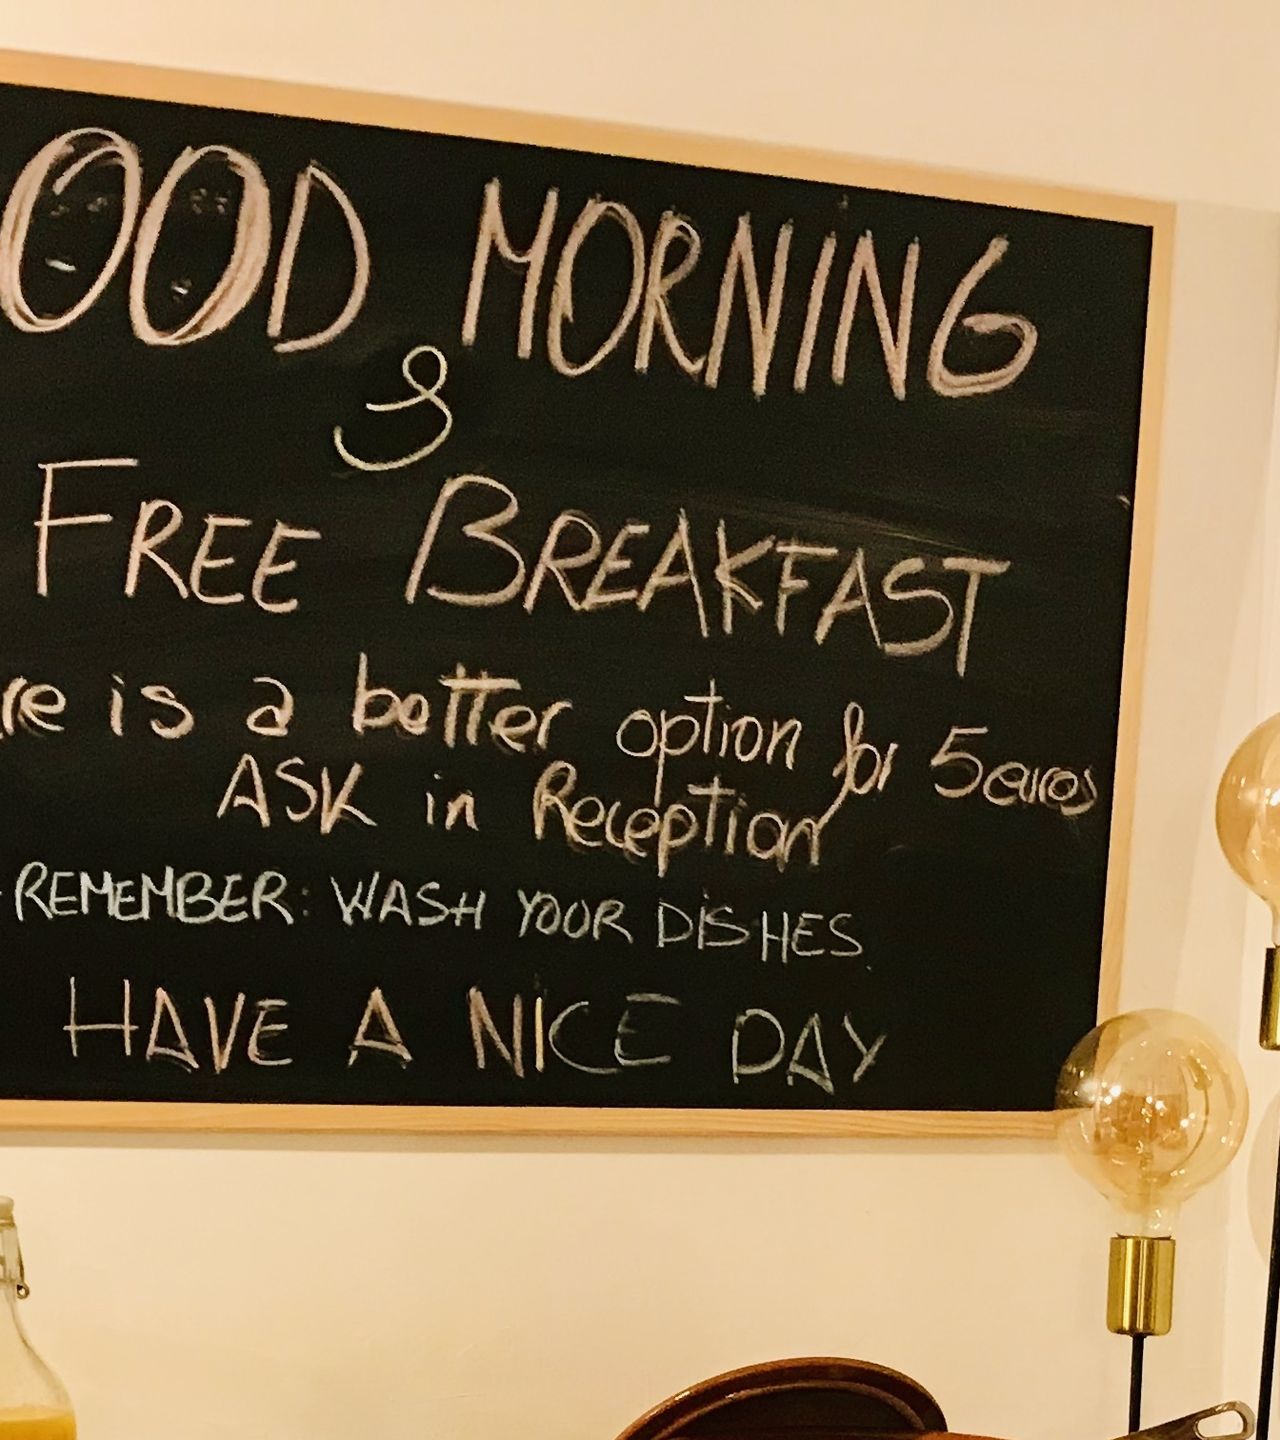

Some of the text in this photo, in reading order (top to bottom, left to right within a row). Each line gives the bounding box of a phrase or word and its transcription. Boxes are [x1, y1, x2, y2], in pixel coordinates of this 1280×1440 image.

[460, 176, 1038, 400] MORNING
[35, 457, 1010, 677] FREE BREAKFAST
[110, 674, 196, 740] is
[246, 676, 294, 737] a
[352, 651, 574, 752] better
[615, 679, 805, 806] option
[820, 701, 898, 826] for
[216, 753, 823, 878] ASK in Reception
[331, 871, 486, 930] WASH
[517, 889, 634, 944] YOUR
[63, 976, 888, 1094] HAVE A NICE DAY
